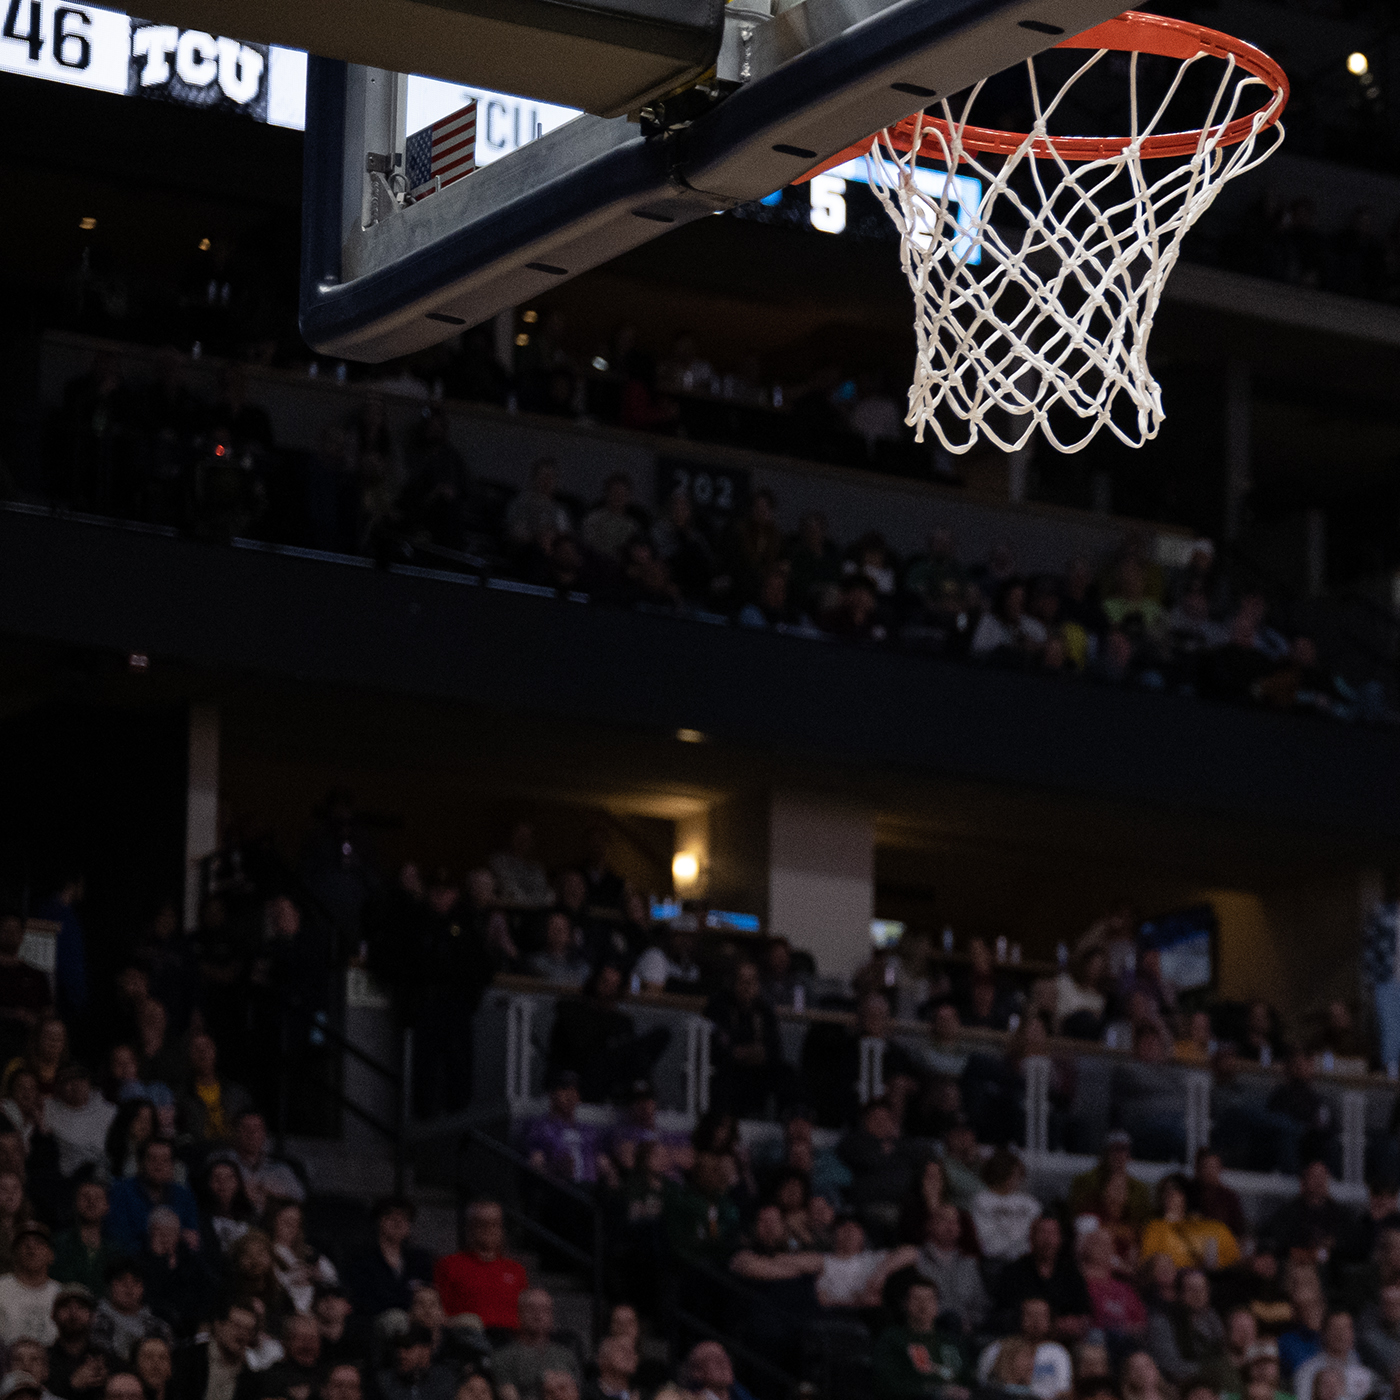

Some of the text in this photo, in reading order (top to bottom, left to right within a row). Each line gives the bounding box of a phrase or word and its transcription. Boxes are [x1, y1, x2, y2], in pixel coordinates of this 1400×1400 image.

[3, 0, 91, 69] 46
[132, 24, 264, 104] TCU
[810, 177, 846, 234] 5
